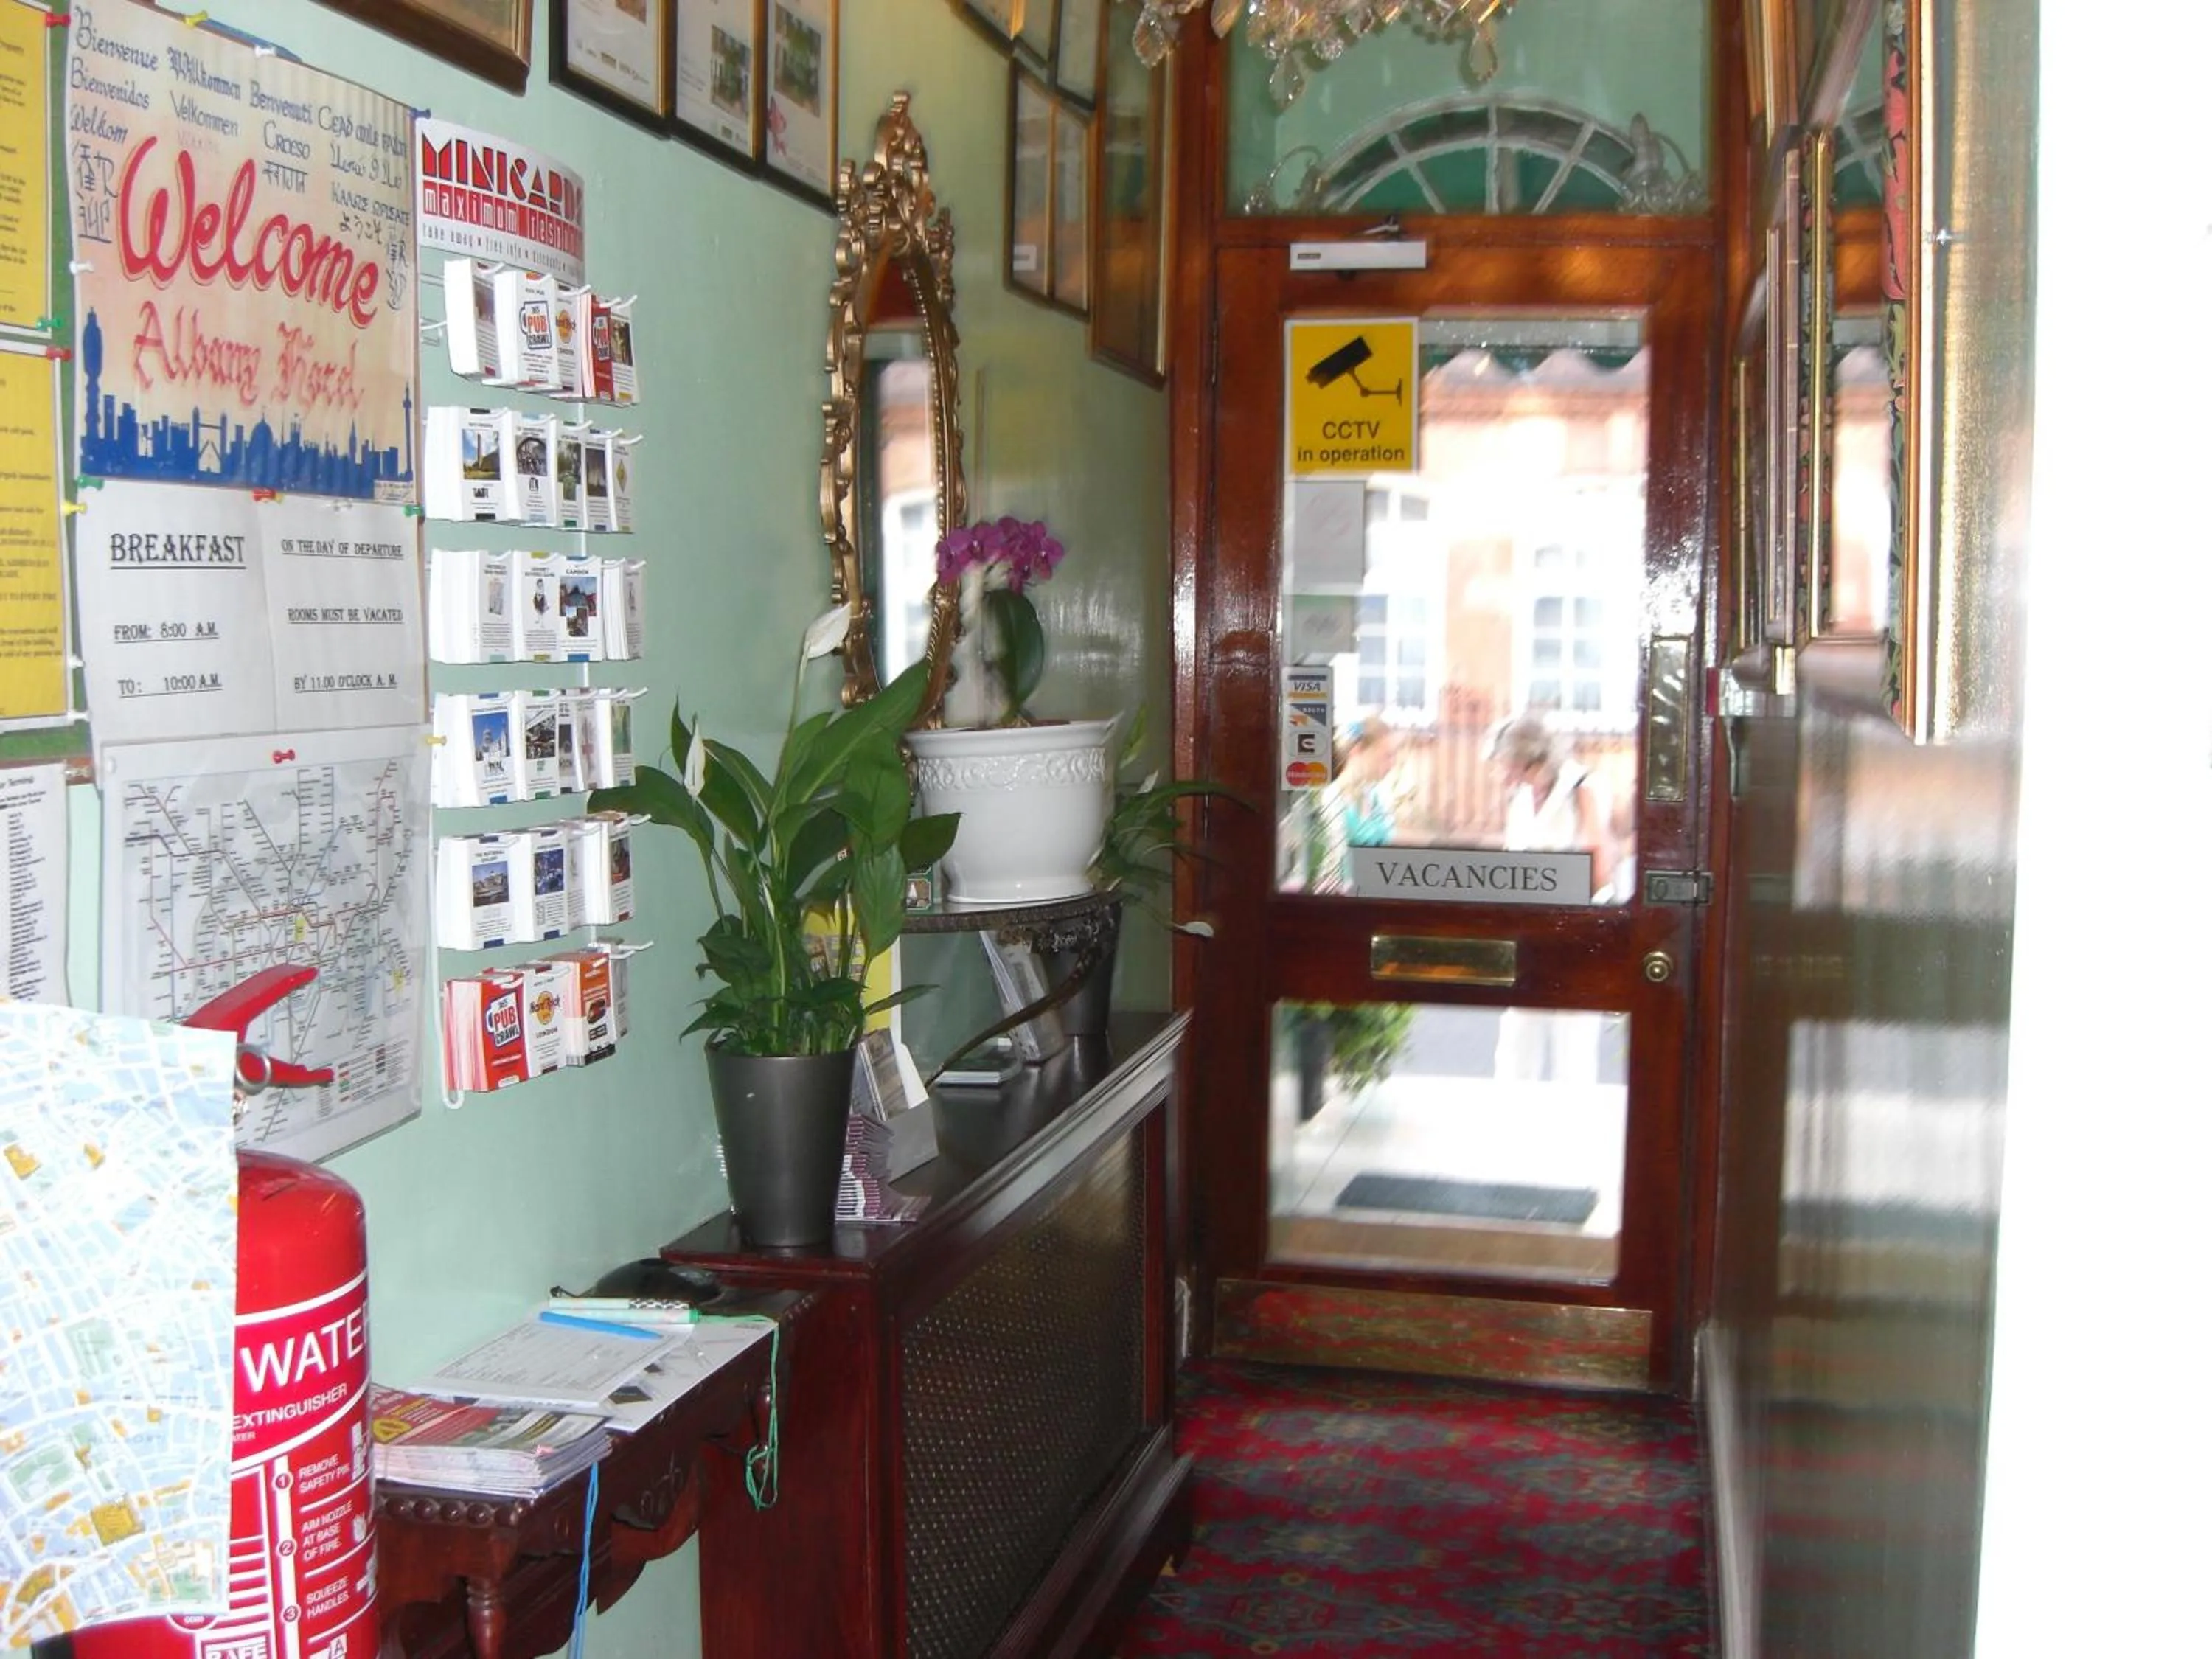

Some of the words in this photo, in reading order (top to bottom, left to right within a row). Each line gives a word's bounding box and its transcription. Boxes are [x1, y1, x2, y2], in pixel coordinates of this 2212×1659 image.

[75, 5, 158, 71] Bienvenue
[71, 55, 150, 110] Bienvenidos
[169, 89, 240, 137] Velkommen
[70, 104, 128, 144] Welkom
[424, 182, 518, 235] maximum
[118, 136, 380, 330] Welcome
[422, 223, 444, 240] take
[526, 314, 549, 333] PUB
[133, 300, 262, 407] Albany
[1322, 420, 1380, 440] CCTV
[1297, 445, 1314, 462] in
[1319, 445, 1405, 465] operation
[110, 532, 247, 564] BREAKFAST
[281, 538, 293, 552] ON
[296, 539, 315, 554] THE
[316, 538, 335, 554] DAY
[338, 542, 349, 554] OF
[354, 543, 404, 557] DEPARTURE
[288, 608, 318, 622] ROOMS
[321, 608, 344, 622] MUST
[347, 608, 360, 621] BE
[363, 607, 403, 622] VACATED
[114, 625, 152, 641] FROM:
[160, 622, 187, 638] 8:00
[164, 674, 196, 691] 10:00
[295, 675, 307, 690] BY
[338, 674, 373, 689] O'CLOCK
[1293, 681, 1321, 692] VISA
[1375, 861, 1558, 891] VACANCIES
[493, 1005, 517, 1031] PUB
[240, 1302, 366, 1393] WATE
[233, 1382, 347, 1429] EXTINGUISHER
[232, 1431, 256, 1442] ATER
[299, 1453, 338, 1480] REMOVE
[299, 1470, 336, 1495] SAFETY
[302, 1533, 316, 1547] AT
[317, 1522, 341, 1540] BASE
[303, 1548, 317, 1562] OF
[307, 1590, 349, 1620] HANDLES
